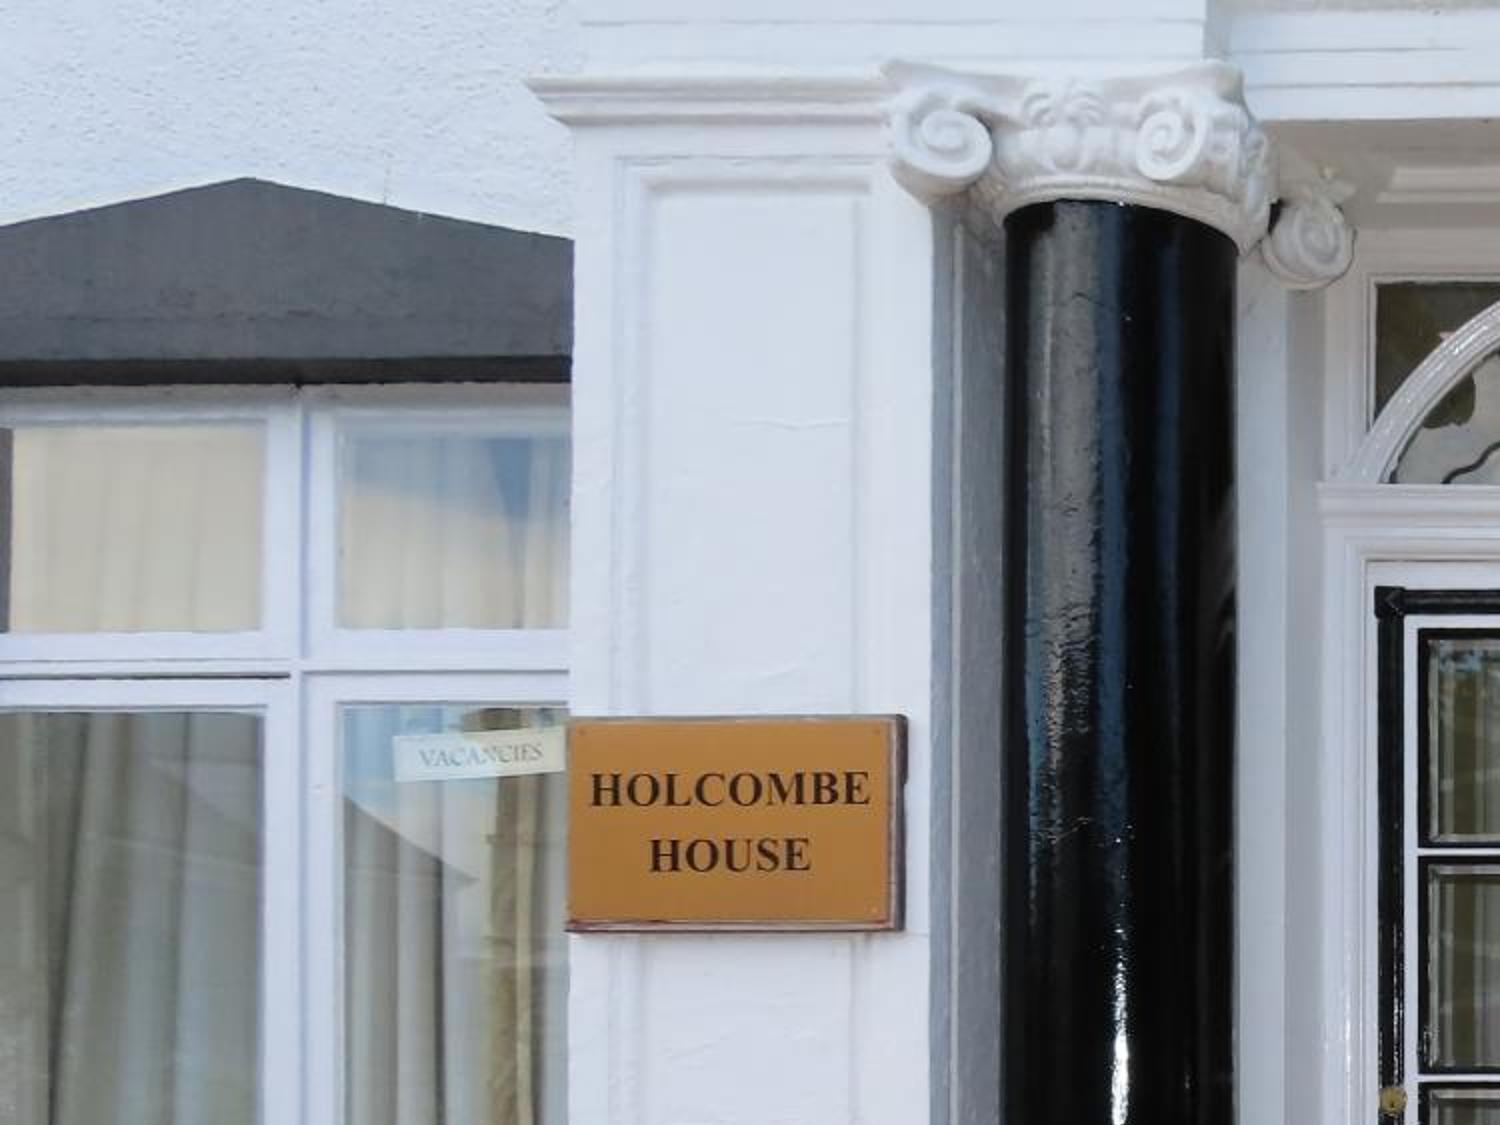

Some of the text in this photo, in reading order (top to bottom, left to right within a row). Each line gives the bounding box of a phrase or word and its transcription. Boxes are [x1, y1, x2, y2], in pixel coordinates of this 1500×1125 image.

[419, 742, 544, 768] VACANCIES
[590, 771, 871, 808] HOLCOMBE
[649, 838, 813, 873] HOUSE
